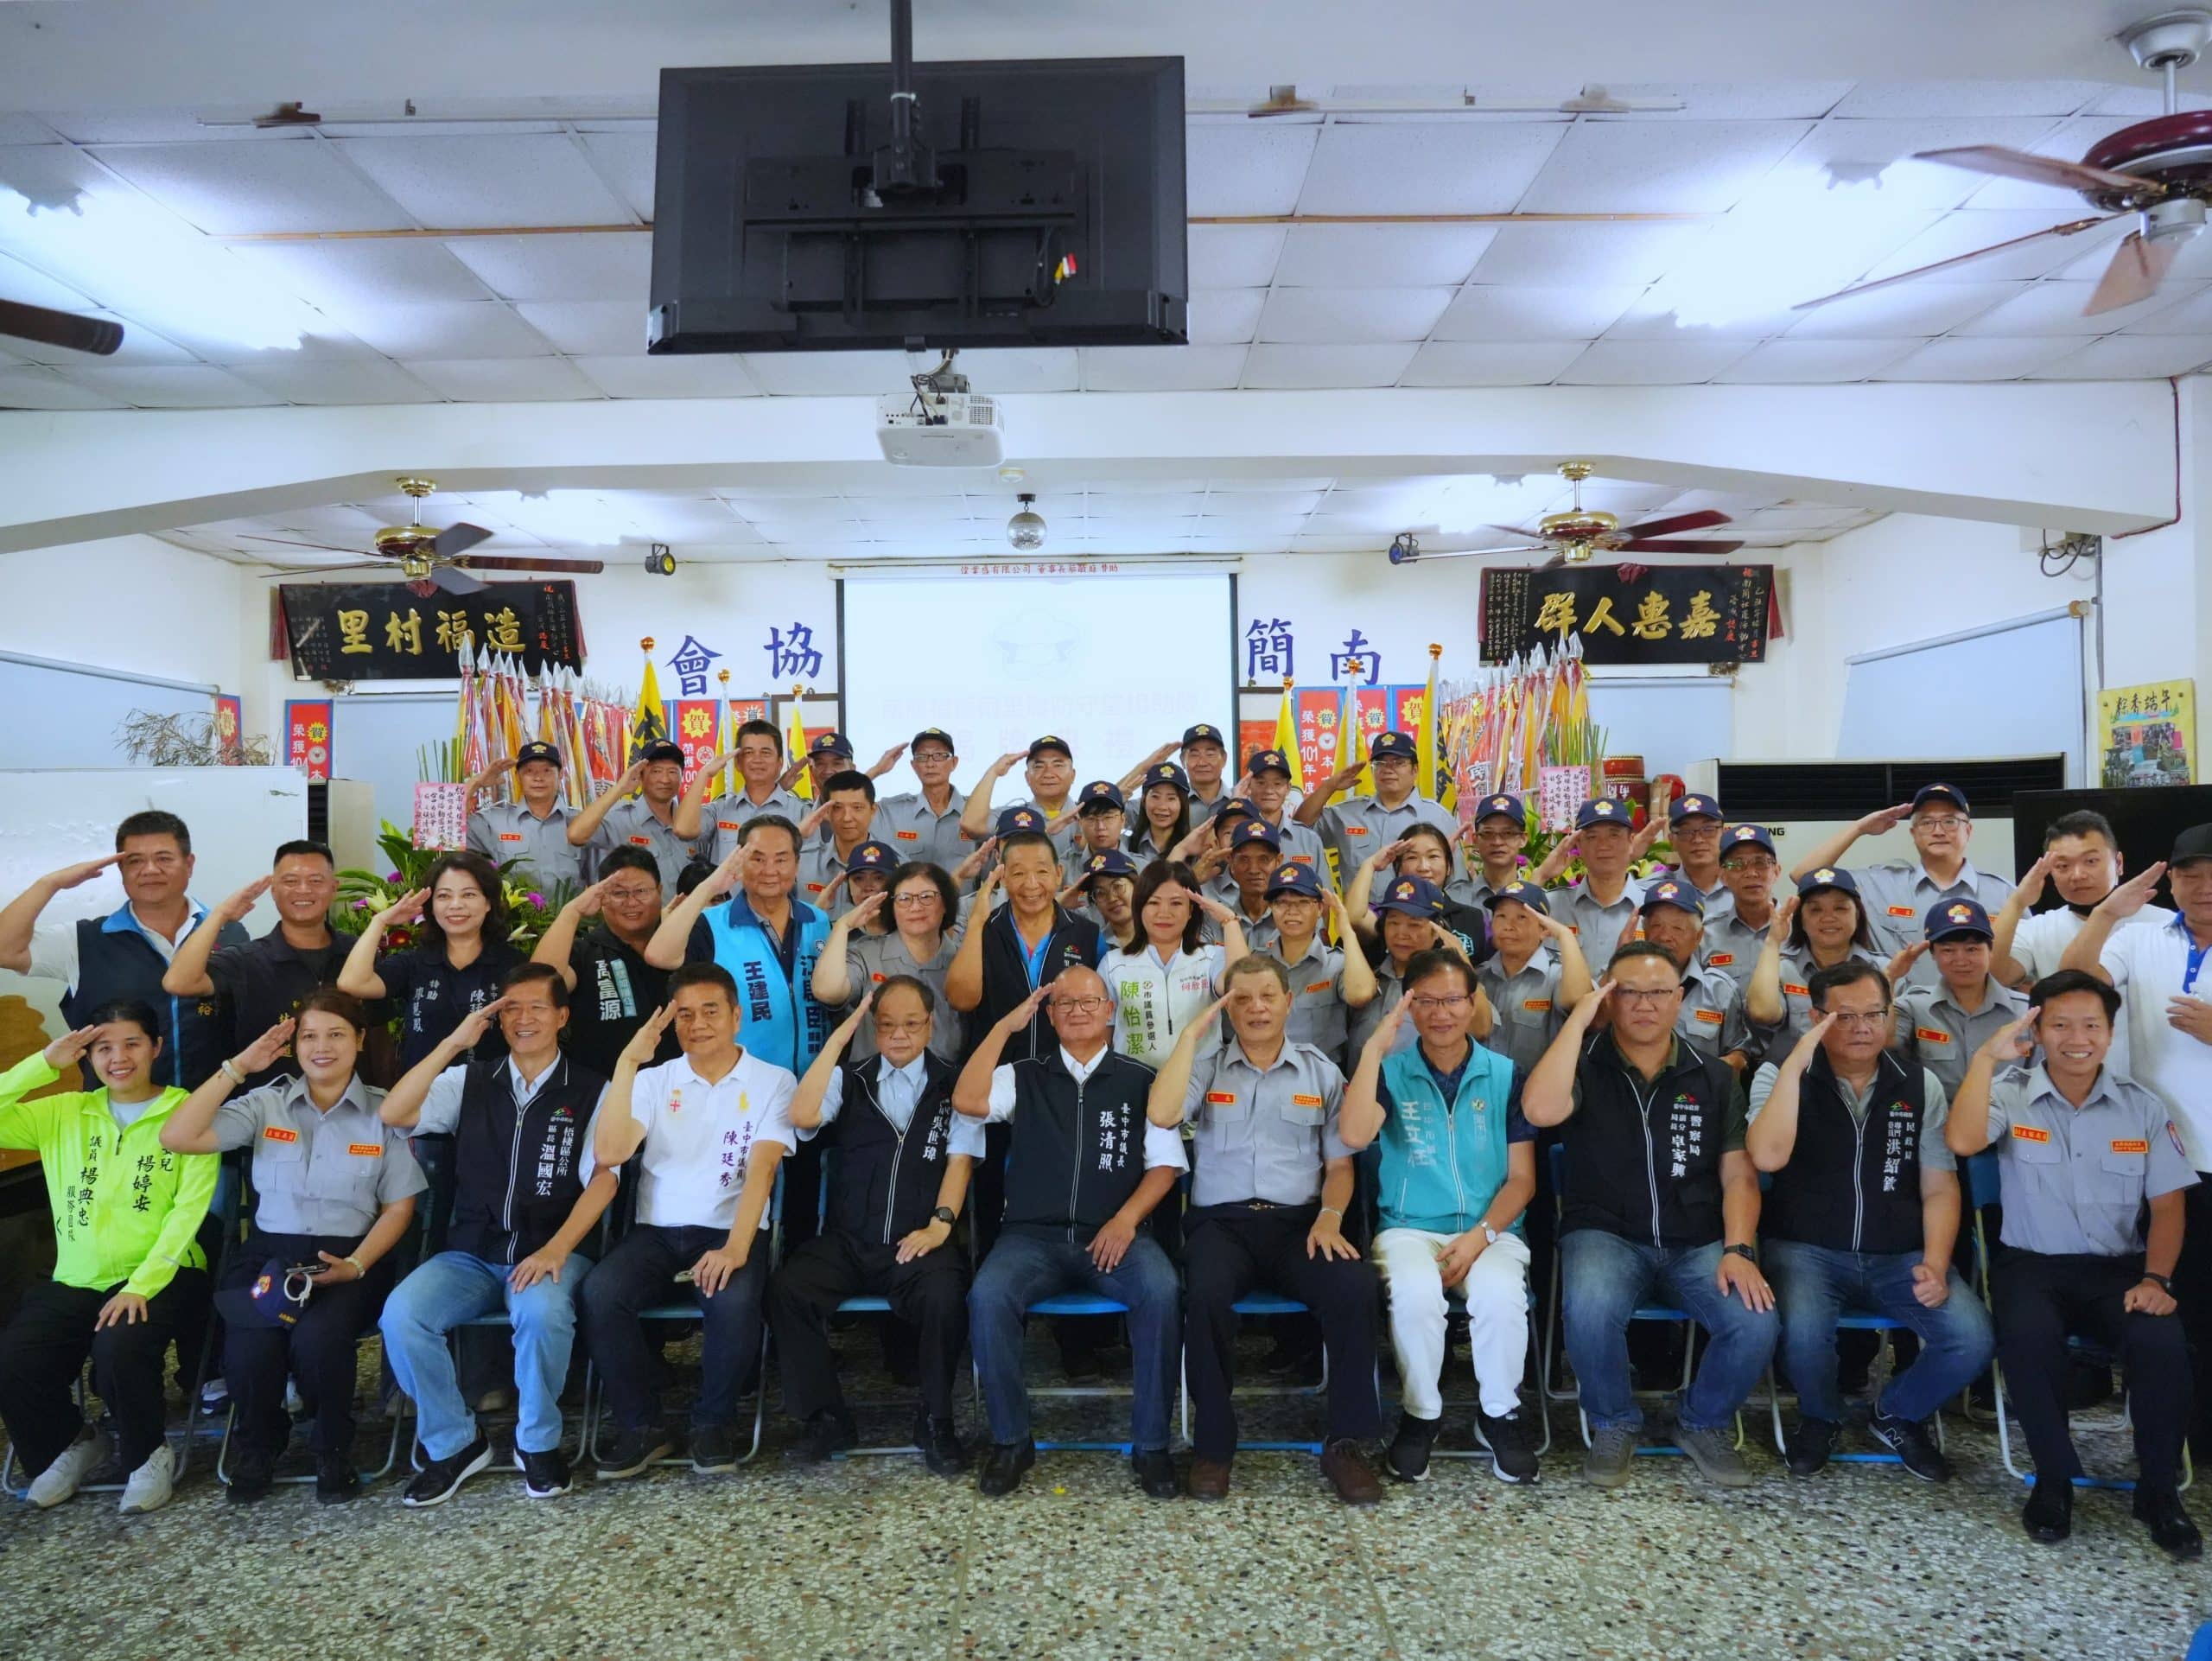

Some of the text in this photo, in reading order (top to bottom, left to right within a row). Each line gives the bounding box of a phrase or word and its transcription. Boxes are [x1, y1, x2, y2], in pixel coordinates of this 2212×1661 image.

[338, 607, 525, 655] 造福村里
[1534, 589, 1722, 640] 嘉惠人群
[690, 714, 706, 731] 賀
[1120, 981, 1145, 1055] 陳怡潔
[1143, 991, 1157, 1052] 市議員參選人
[536, 1143, 556, 1196] 溫國宏
[719, 1130, 739, 1187] 陳廷秀
[1099, 1111, 1117, 1173] 張清照
[78, 1167, 99, 1227] 楊典忠
[132, 1155, 156, 1212] 楊婷安
